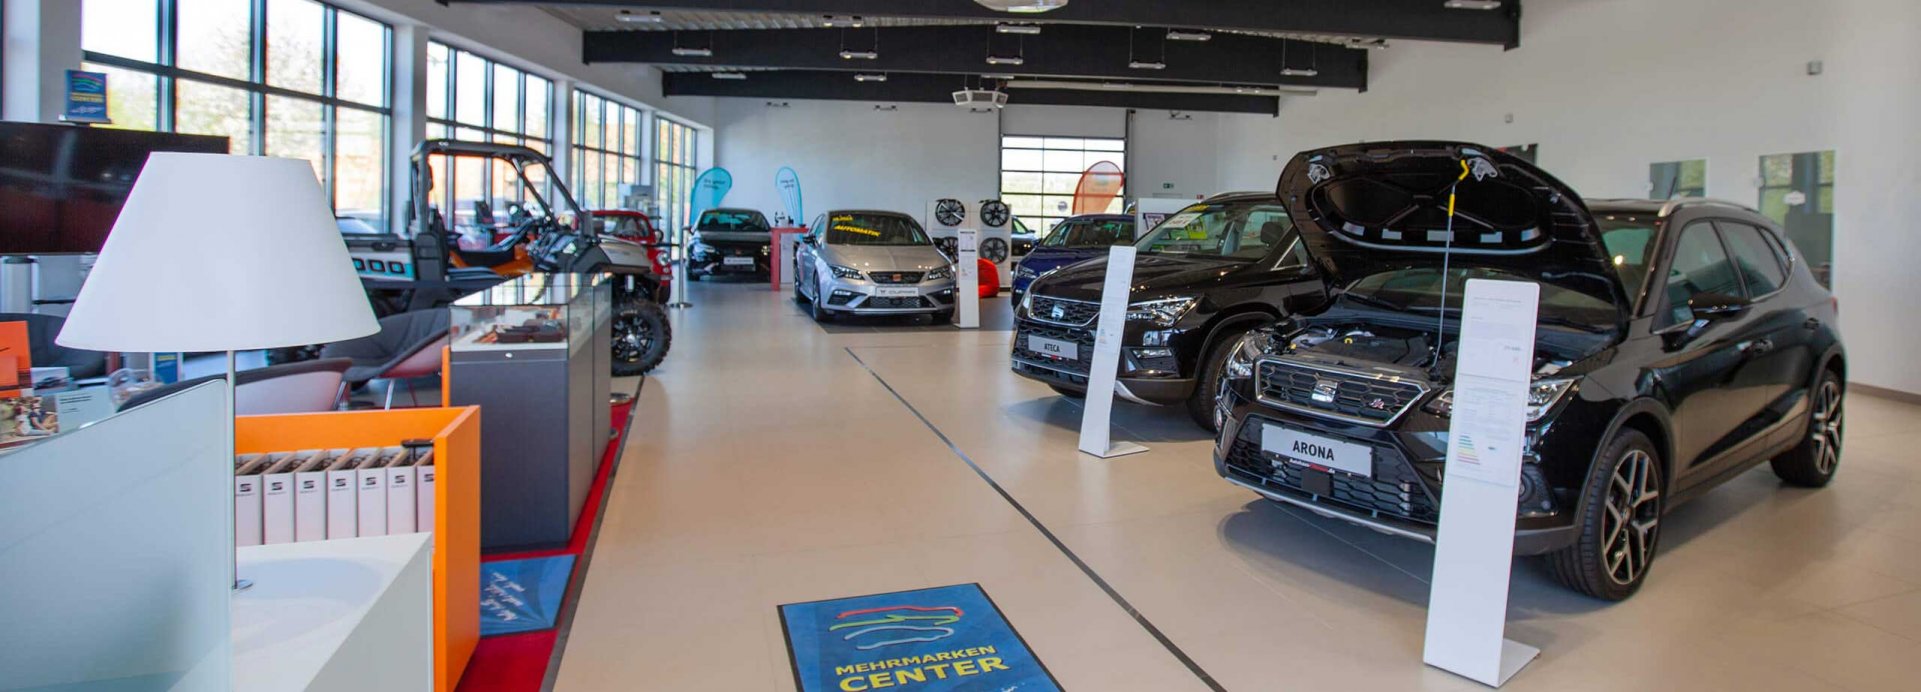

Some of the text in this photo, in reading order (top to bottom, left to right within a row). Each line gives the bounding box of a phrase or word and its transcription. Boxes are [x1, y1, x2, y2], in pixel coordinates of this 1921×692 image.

[834, 225, 880, 237] AUTOMATIK
[1044, 343, 1060, 353] ATECA
[1292, 440, 1335, 461] ARONA
[835, 645, 997, 676] MEHRMARKEN
[839, 656, 1010, 692] CENTER
